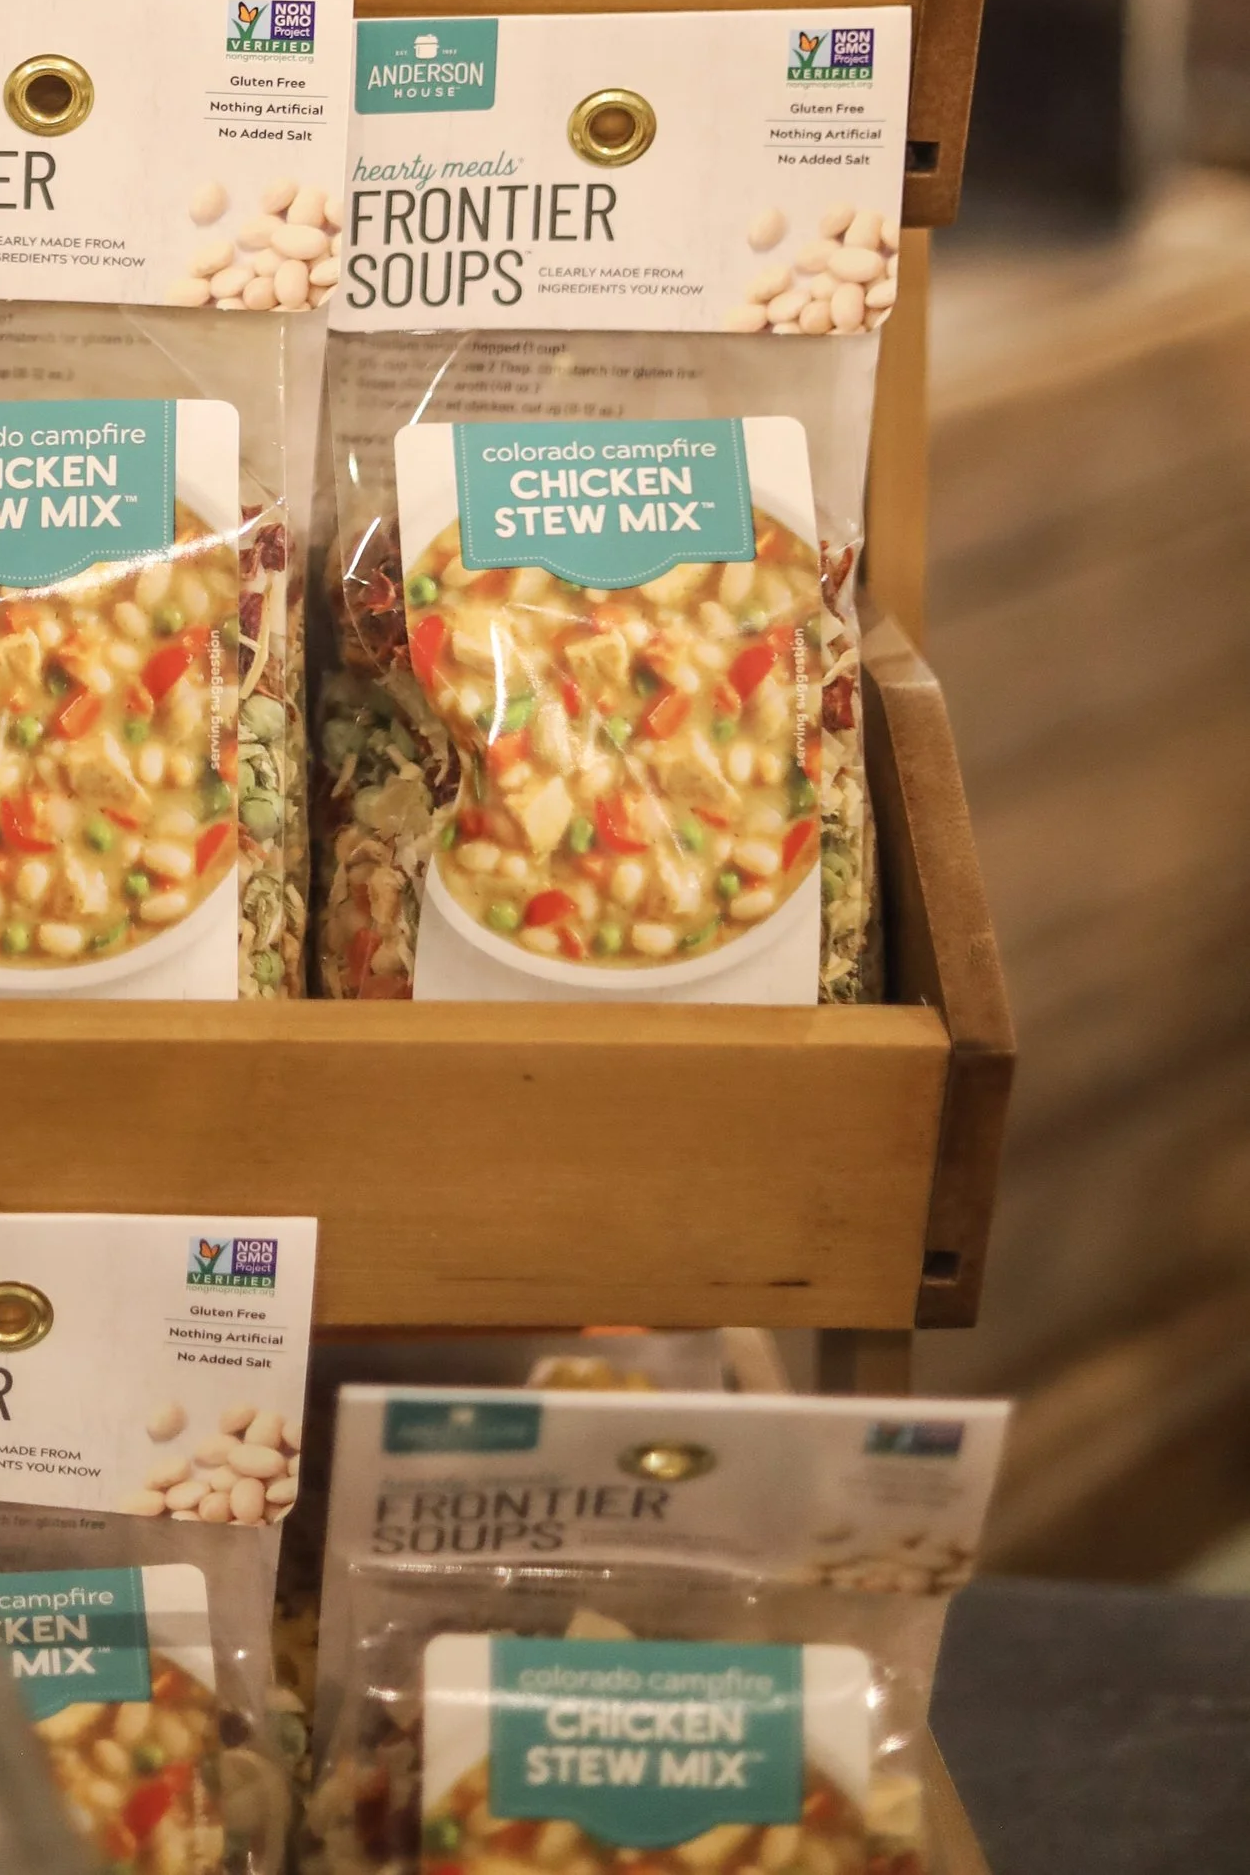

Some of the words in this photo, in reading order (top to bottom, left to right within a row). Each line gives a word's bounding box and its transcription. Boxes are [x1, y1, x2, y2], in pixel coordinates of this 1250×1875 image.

[275, 3, 311, 15] NON
[274, 15, 311, 27] GMO
[274, 27, 310, 38] Project
[835, 31, 870, 43] NON
[231, 41, 310, 52] VERIFIED
[834, 43, 870, 54] GMO
[226, 53, 314, 64] nongmoproject.org
[834, 55, 869, 65] Project
[368, 62, 484, 90] ANDERSON
[792, 69, 870, 78] VERIFIED
[230, 76, 273, 87] Gluten
[277, 78, 306, 88] Free
[394, 87, 455, 98] HOUSE
[210, 102, 263, 116] Nothing
[266, 104, 323, 115] Artificial
[790, 103, 832, 114] Gluten
[836, 103, 864, 114] Free
[219, 128, 237, 138] No
[240, 129, 283, 140] Added
[287, 130, 312, 141] Salt
[770, 129, 822, 142] Nothing
[825, 129, 882, 140] Artificial
[778, 155, 796, 164] No
[799, 155, 842, 165] Added
[845, 155, 870, 165] Salt
[352, 154, 437, 191] hearty
[350, 183, 616, 246] FRONTIER
[41, 237, 82, 248] MADE
[85, 239, 126, 250] FROM
[71, 255, 99, 266] YOU
[103, 256, 146, 268] KNOW
[31, 423, 146, 450] campfire
[482, 441, 595, 463] colorado
[602, 438, 717, 463] campfire
[510, 467, 693, 500] CHICKEN
[494, 504, 606, 538] STEW
[208, 629, 224, 712] suggestion
[208, 715, 224, 770] serving
[237, 1241, 272, 1253] NON
[237, 1252, 272, 1263] GMO
[236, 1263, 271, 1274] Project
[192, 1274, 271, 1287] VERIFIED
[190, 1306, 233, 1317] Gluten
[237, 1309, 266, 1320] Free
[170, 1327, 222, 1343] Nothing
[226, 1333, 283, 1345] Artificial
[178, 1352, 196, 1362] No
[199, 1354, 242, 1366] Added
[246, 1357, 272, 1368] Salt
[40, 1448, 81, 1460] FROM
[27, 1461, 56, 1474] YOU
[58, 1464, 102, 1477] KNOW
[376, 1486, 671, 1523] FRONTIER
[372, 1523, 564, 1555] SOUPS
[546, 1701, 746, 1743] CHICKEN
[525, 1745, 648, 1787] STEW
